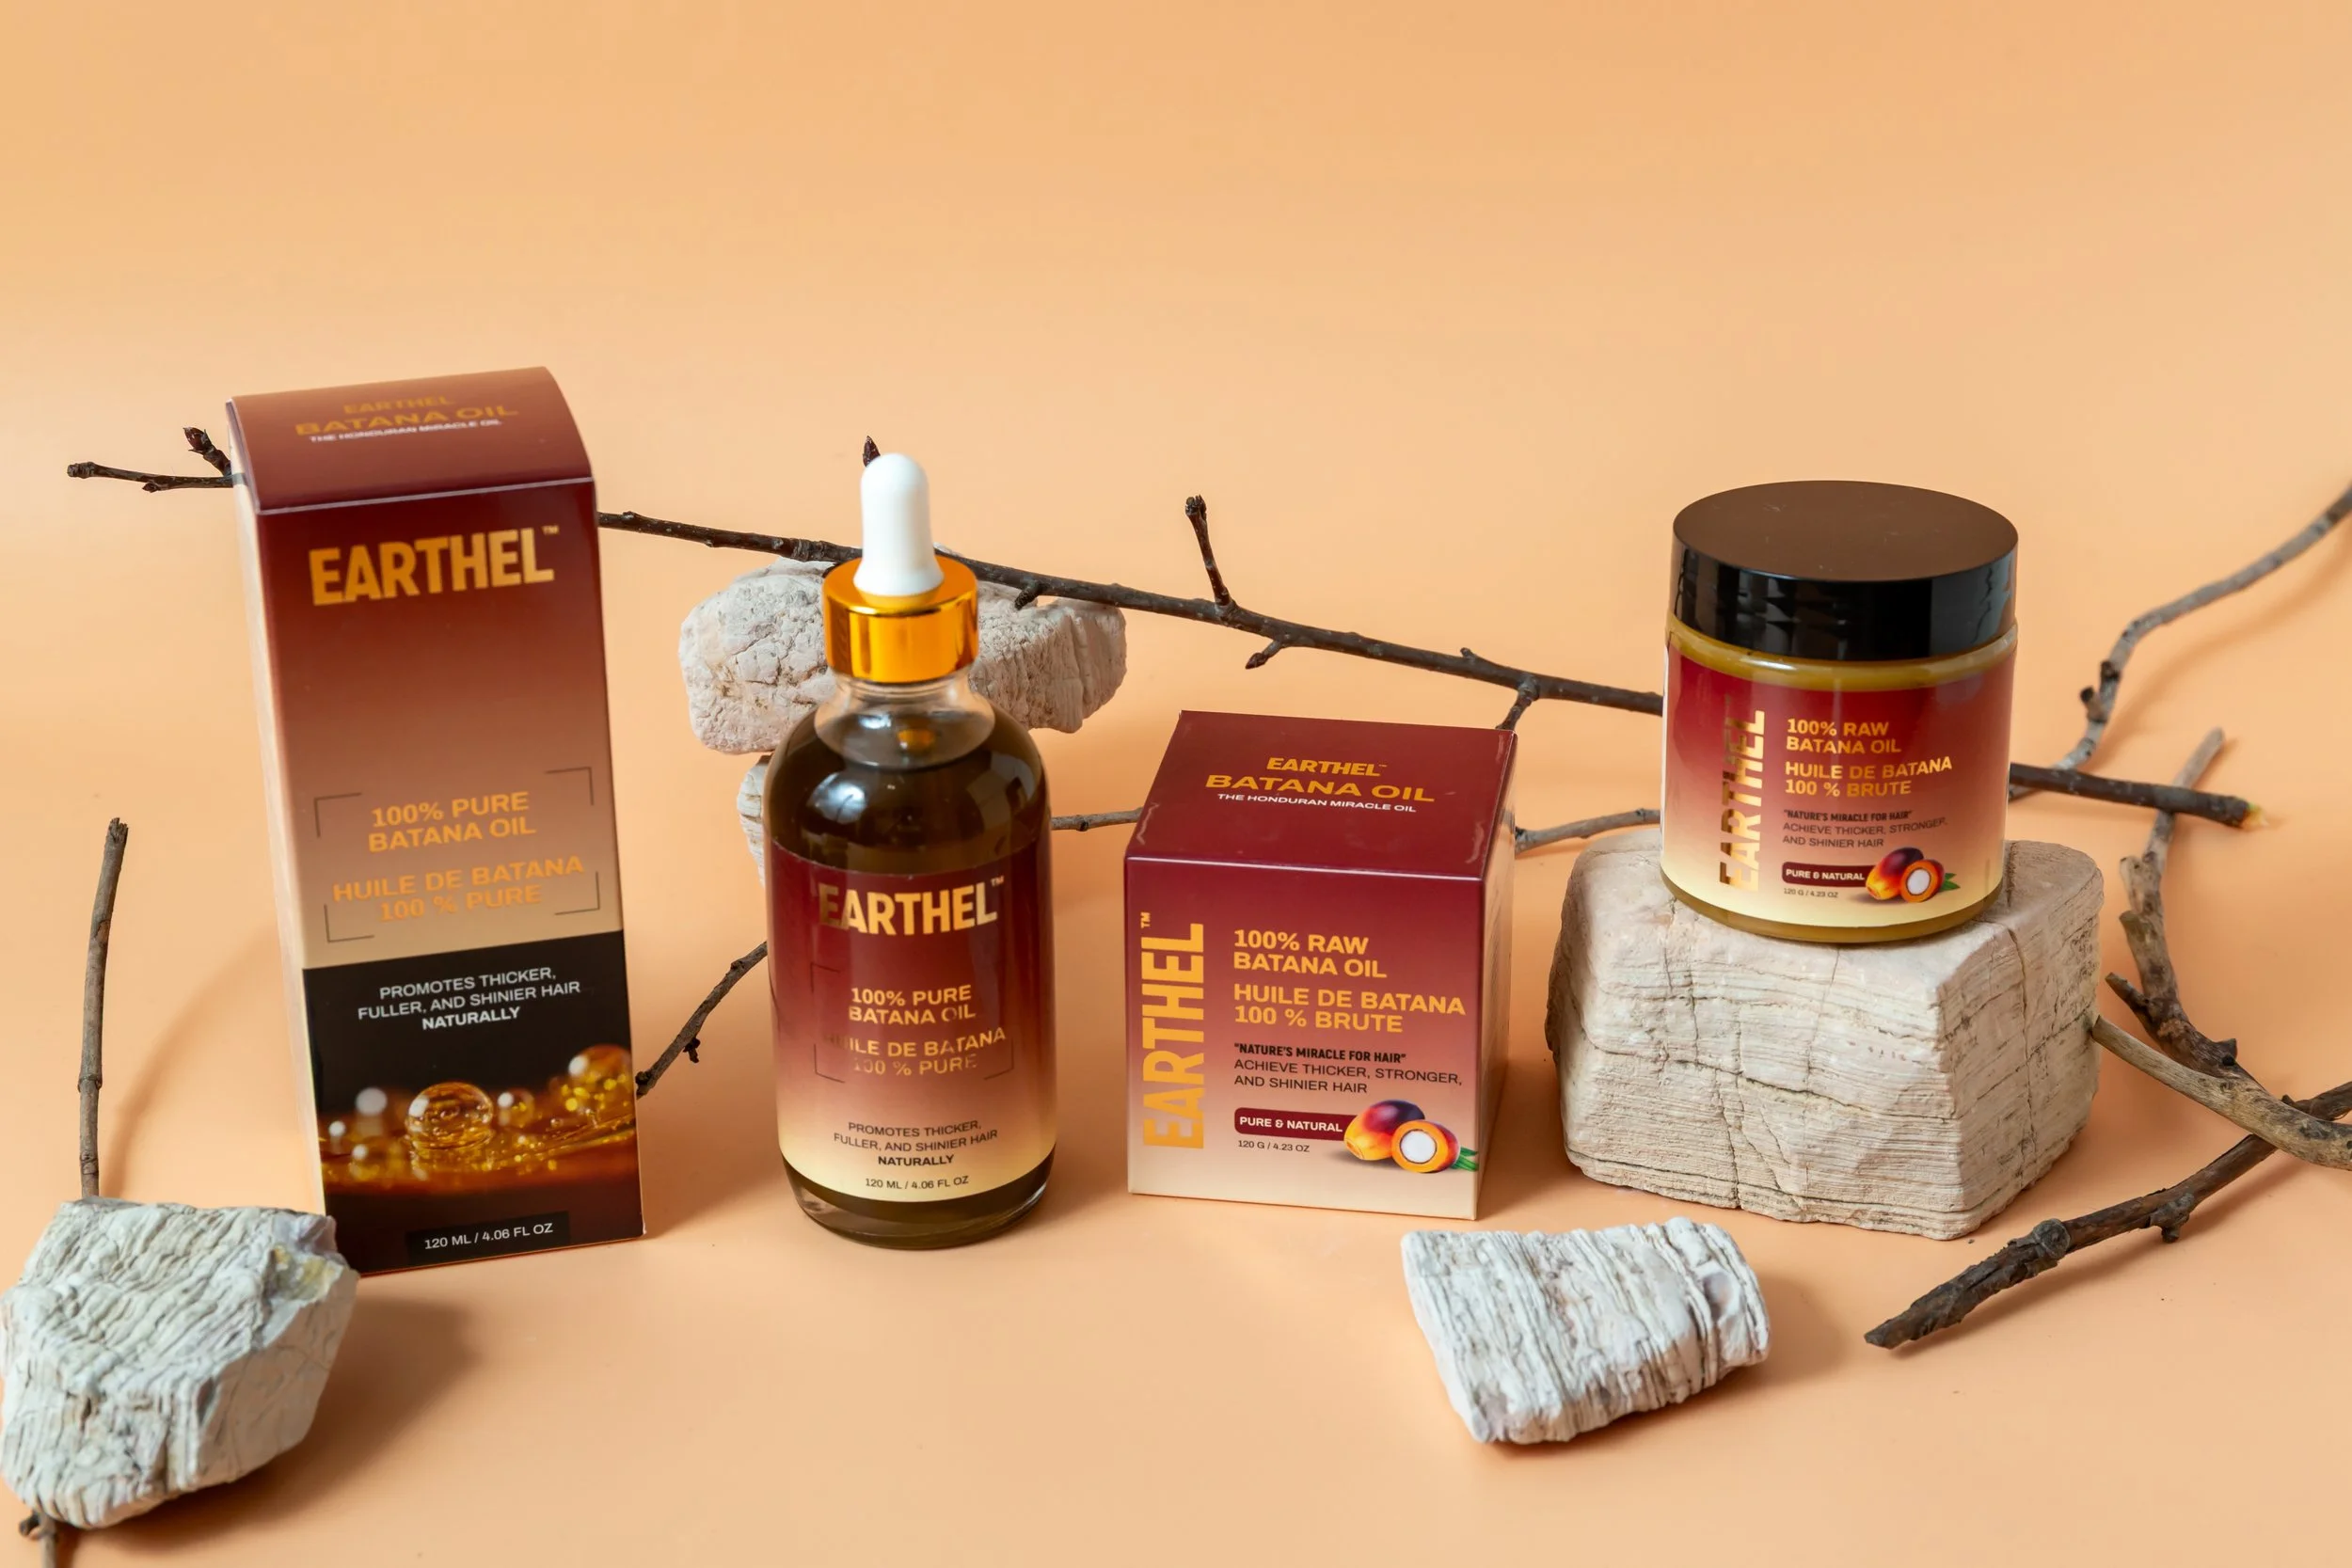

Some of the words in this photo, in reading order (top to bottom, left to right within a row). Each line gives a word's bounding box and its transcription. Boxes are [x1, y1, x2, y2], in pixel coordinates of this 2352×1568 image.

[295, 411, 449, 436] BATANA
[455, 404, 519, 420] OIL
[310, 434, 336, 443] THE
[1788, 718, 1837, 736] 100%
[1843, 721, 1889, 736] RAW
[1786, 736, 1866, 754] BATANA
[1870, 738, 1902, 753] OIL
[1785, 761, 1843, 780] HUILE
[1849, 766, 1876, 780] DE
[1882, 756, 1952, 779] BATANA
[1205, 774, 1361, 797] BATANA
[1371, 784, 1436, 802] OIL
[1785, 779, 1818, 796] 100
[1823, 782, 1841, 798] %
[1847, 780, 1912, 798] BRUTE
[371, 801, 444, 828] 100%
[452, 791, 530, 818] PURE
[1247, 795, 1327, 806] HONDURAN
[1330, 800, 1391, 811] MIRACLE
[1394, 804, 1417, 813] OIL
[1830, 813, 1868, 822] MIRACLE
[1870, 812, 1887, 821] FOR
[368, 821, 483, 853] BATANA
[489, 816, 537, 838] OIL
[1783, 822, 1831, 834] ACHIEVE
[1835, 826, 1886, 835] THICKER,
[1783, 835, 1805, 845] AND
[1809, 837, 1854, 847] SHINIER
[1857, 838, 1884, 847] HAIR
[332, 875, 417, 902] HUILE
[425, 869, 464, 892] DE
[471, 855, 584, 886] BATANA
[1786, 869, 1810, 879] PURE
[1813, 870, 1820, 879] &
[1821, 871, 1866, 880] NATURAL
[379, 898, 424, 923] 100
[433, 896, 457, 914] %
[466, 884, 542, 911] PURE
[1233, 929, 1300, 951] 100%
[1308, 934, 1369, 955] RAW
[1233, 951, 1338, 975] BATANA
[1344, 959, 1388, 978] OIL
[379, 976, 475, 1000] PROMOTES
[479, 966, 556, 988] THICKER,
[358, 1002, 426, 1021] FULLER,
[430, 996, 466, 1012] AND
[470, 988, 537, 1006] SHINIER
[541, 981, 580, 997] HAIR
[850, 987, 906, 1006] 100%
[913, 984, 972, 1006] PURE
[1233, 983, 1310, 1006] HUILE
[1317, 989, 1353, 1008] DE
[1361, 990, 1466, 1016] BATANA
[421, 1006, 521, 1031] NATURALLY
[849, 1006, 936, 1025] BATANA
[941, 1004, 977, 1022] OIL
[1234, 1006, 1277, 1025] 100
[1284, 1008, 1307, 1028] %
[1315, 1010, 1404, 1033] BRUTE
[887, 1041, 917, 1057] DE
[924, 1026, 1007, 1056] BATANA
[853, 1056, 886, 1076] 100
[893, 1061, 913, 1076] %
[919, 1053, 977, 1075] PURE
[1296, 1047, 1345, 1061] MIRACLE
[1349, 1051, 1371, 1062] FOR
[1234, 1059, 1298, 1074] ACHIEVE
[1302, 1063, 1371, 1079] THICKER,
[1375, 1068, 1463, 1086] STRONGER,
[1234, 1075, 1265, 1087] AND
[1269, 1077, 1328, 1092] SHINIER
[1332, 1083, 1367, 1093] HAIR
[848, 1121, 920, 1137] PROMOTES
[924, 1119, 981, 1136] THICKER,
[1239, 1117, 1272, 1128] PURE
[1275, 1118, 1284, 1129] &
[1286, 1119, 1343, 1132] NATURAL
[834, 1132, 882, 1151] FULLER,
[884, 1142, 912, 1152] AND
[915, 1137, 967, 1152] SHINIER
[970, 1130, 998, 1145] HAIR
[1238, 1140, 1255, 1148] 120
[1257, 1141, 1264, 1149] G
[1272, 1142, 1294, 1151] 4.23
[1295, 1144, 1310, 1153] OZ
[878, 1154, 955, 1166] NATURALLY
[866, 1178, 883, 1188] 120
[886, 1180, 903, 1190] ML
[911, 1180, 934, 1189] 4.06
[953, 1176, 969, 1185] OZ
[424, 1237, 448, 1250] 120
[452, 1234, 471, 1246] ML
[482, 1228, 510, 1242] 4.06
[513, 1227, 531, 1237] FL
[532, 1223, 553, 1235] OZ
